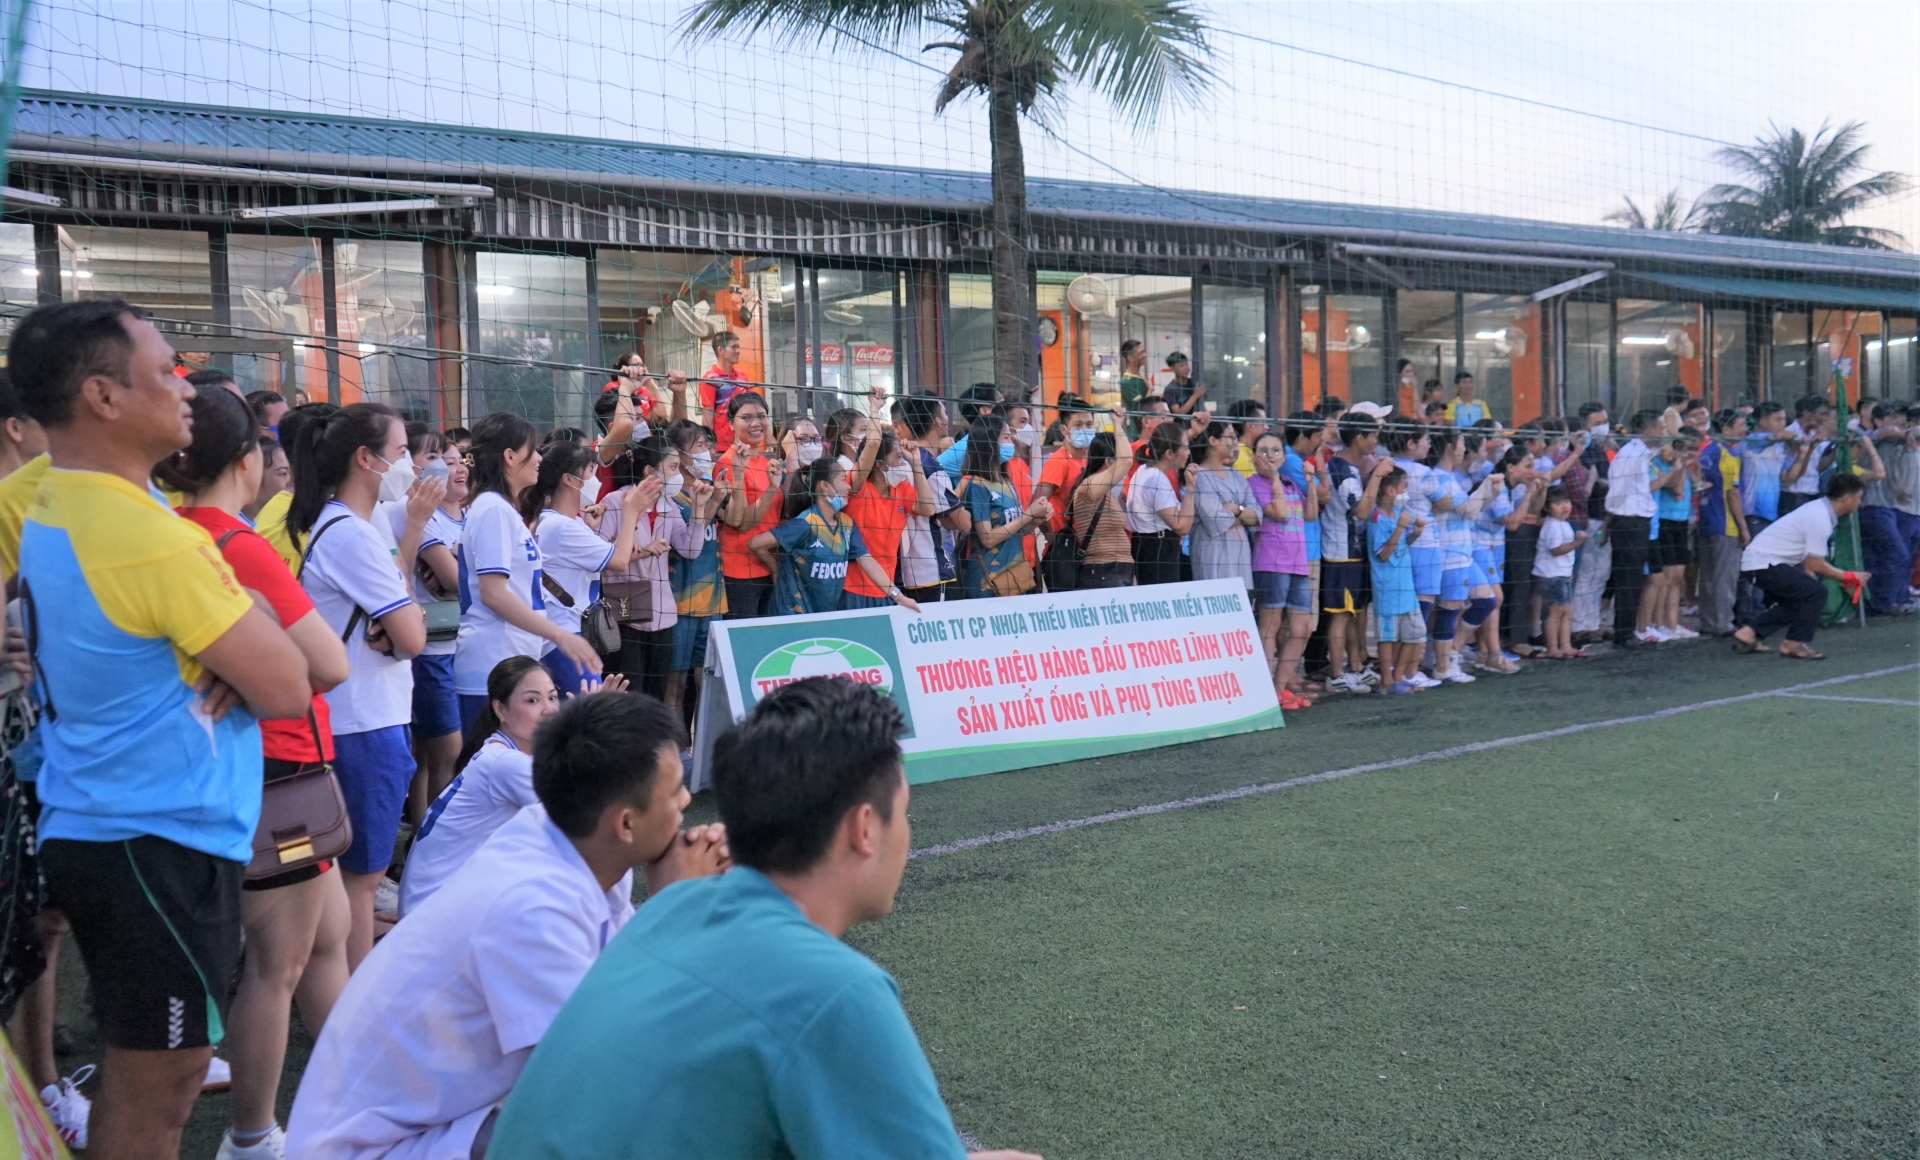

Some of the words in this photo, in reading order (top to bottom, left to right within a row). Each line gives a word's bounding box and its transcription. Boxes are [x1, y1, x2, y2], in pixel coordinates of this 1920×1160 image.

[856, 347, 893, 362] Coca-Cola
[907, 618, 947, 644] CÔNG
[948, 618, 966, 640] TY
[968, 616, 986, 638] CP
[989, 611, 1028, 639] NHỰA
[1028, 603, 1066, 632] THIẾU
[1067, 603, 1100, 628] NIÊN
[1100, 598, 1130, 625] TIỀN
[1130, 600, 1172, 622] PHONG
[1171, 592, 1204, 618] MIỀN
[1203, 593, 1242, 615] TRUNG
[757, 677, 806, 696] TI
[916, 658, 994, 694] THƯƠNG
[994, 649, 1038, 689] HIỆU
[1039, 645, 1091, 680] HÀNG
[1090, 636, 1127, 674] ĐẦU
[1127, 638, 1183, 669] TRONG
[1183, 631, 1222, 663] LĨNH
[1221, 628, 1253, 662] VỰC
[957, 695, 998, 736] SẢN
[999, 687, 1047, 730] XUẤT
[1050, 684, 1089, 723] ỐNG
[1089, 683, 1116, 717] VÀ
[1115, 683, 1152, 717] PHỤ
[1151, 675, 1197, 708] TÙNG
[1196, 670, 1243, 705] NHỰA
